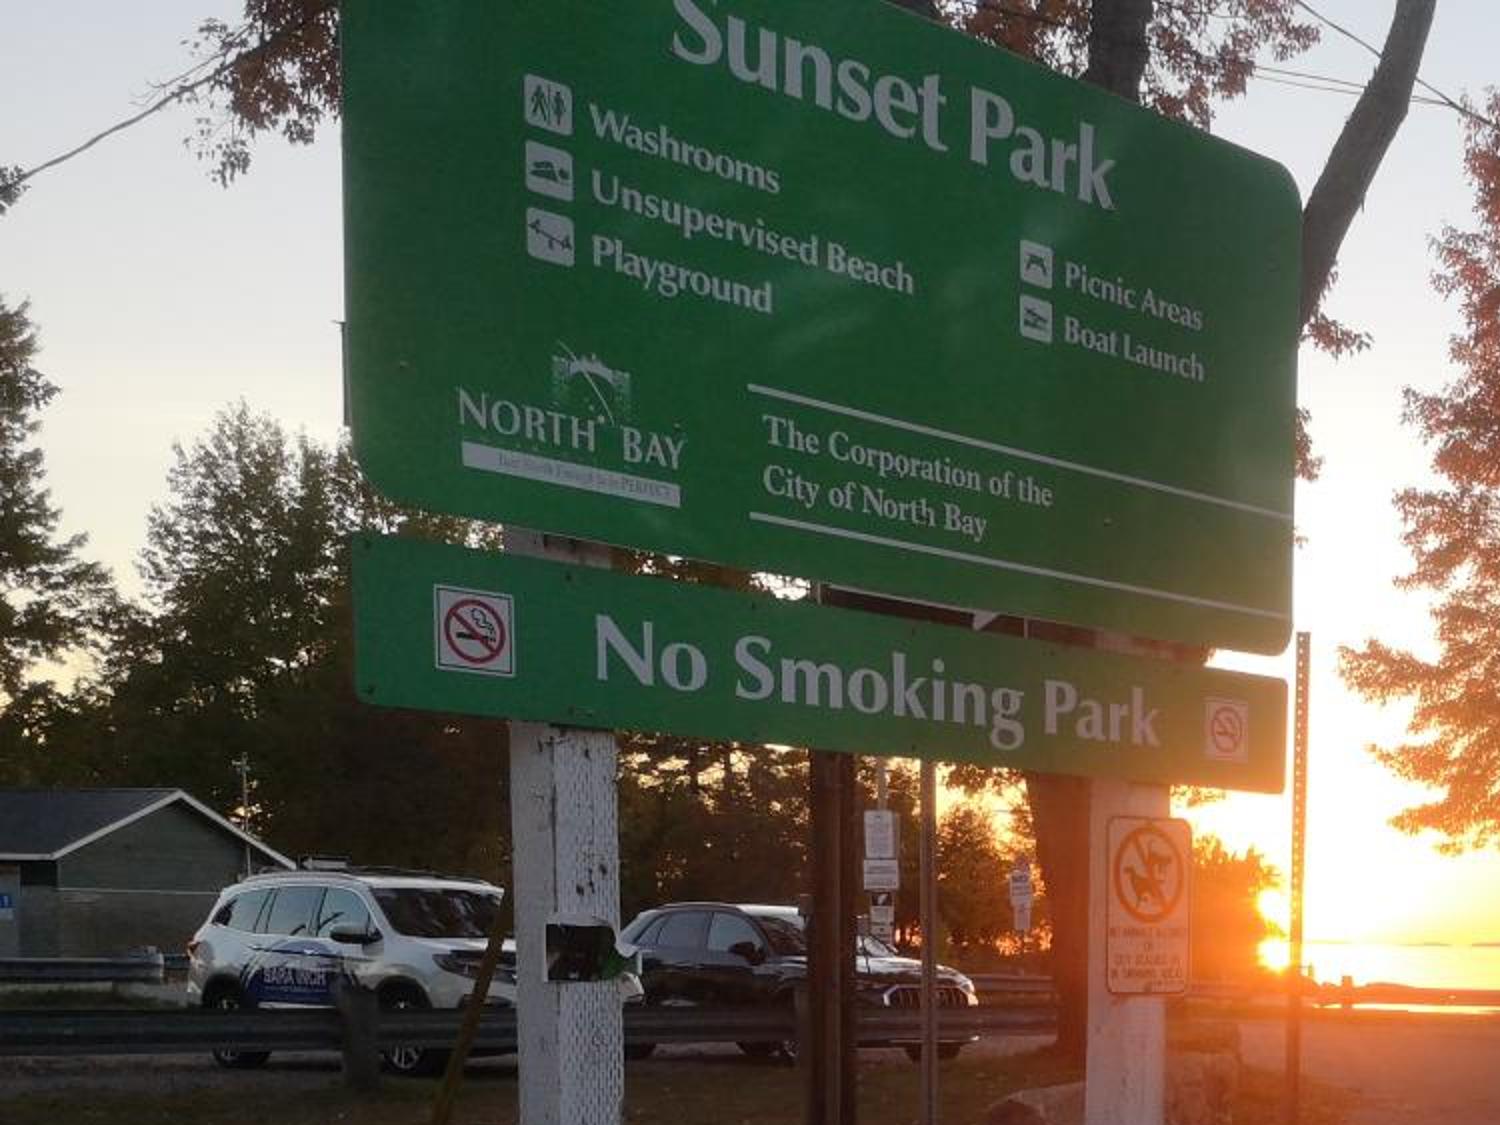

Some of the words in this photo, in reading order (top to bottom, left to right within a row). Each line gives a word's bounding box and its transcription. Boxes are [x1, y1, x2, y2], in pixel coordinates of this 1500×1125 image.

[589, 103, 781, 194] Washrooms
[672, 0, 949, 151] Sunset
[970, 86, 1117, 210] Park
[592, 170, 820, 267] Unsupervised
[826, 242, 914, 295] Beach
[592, 235, 773, 314] Playground
[1065, 260, 1136, 310] Picnic
[1142, 287, 1203, 331] Areas
[1065, 315, 1118, 357] Boat
[1124, 333, 1204, 381] Launch
[456, 387, 596, 451] NORTH
[620, 425, 687, 470] BAY
[762, 415, 819, 455] The
[828, 431, 981, 493] Corporation
[989, 470, 1012, 498] of
[1018, 477, 1053, 507] the
[763, 465, 818, 508] City
[829, 482, 854, 508] of
[862, 485, 936, 528] North
[944, 502, 987, 542] Bay
[596, 614, 707, 691] No
[735, 636, 1025, 750] Smoking
[1043, 680, 1163, 748] Park
